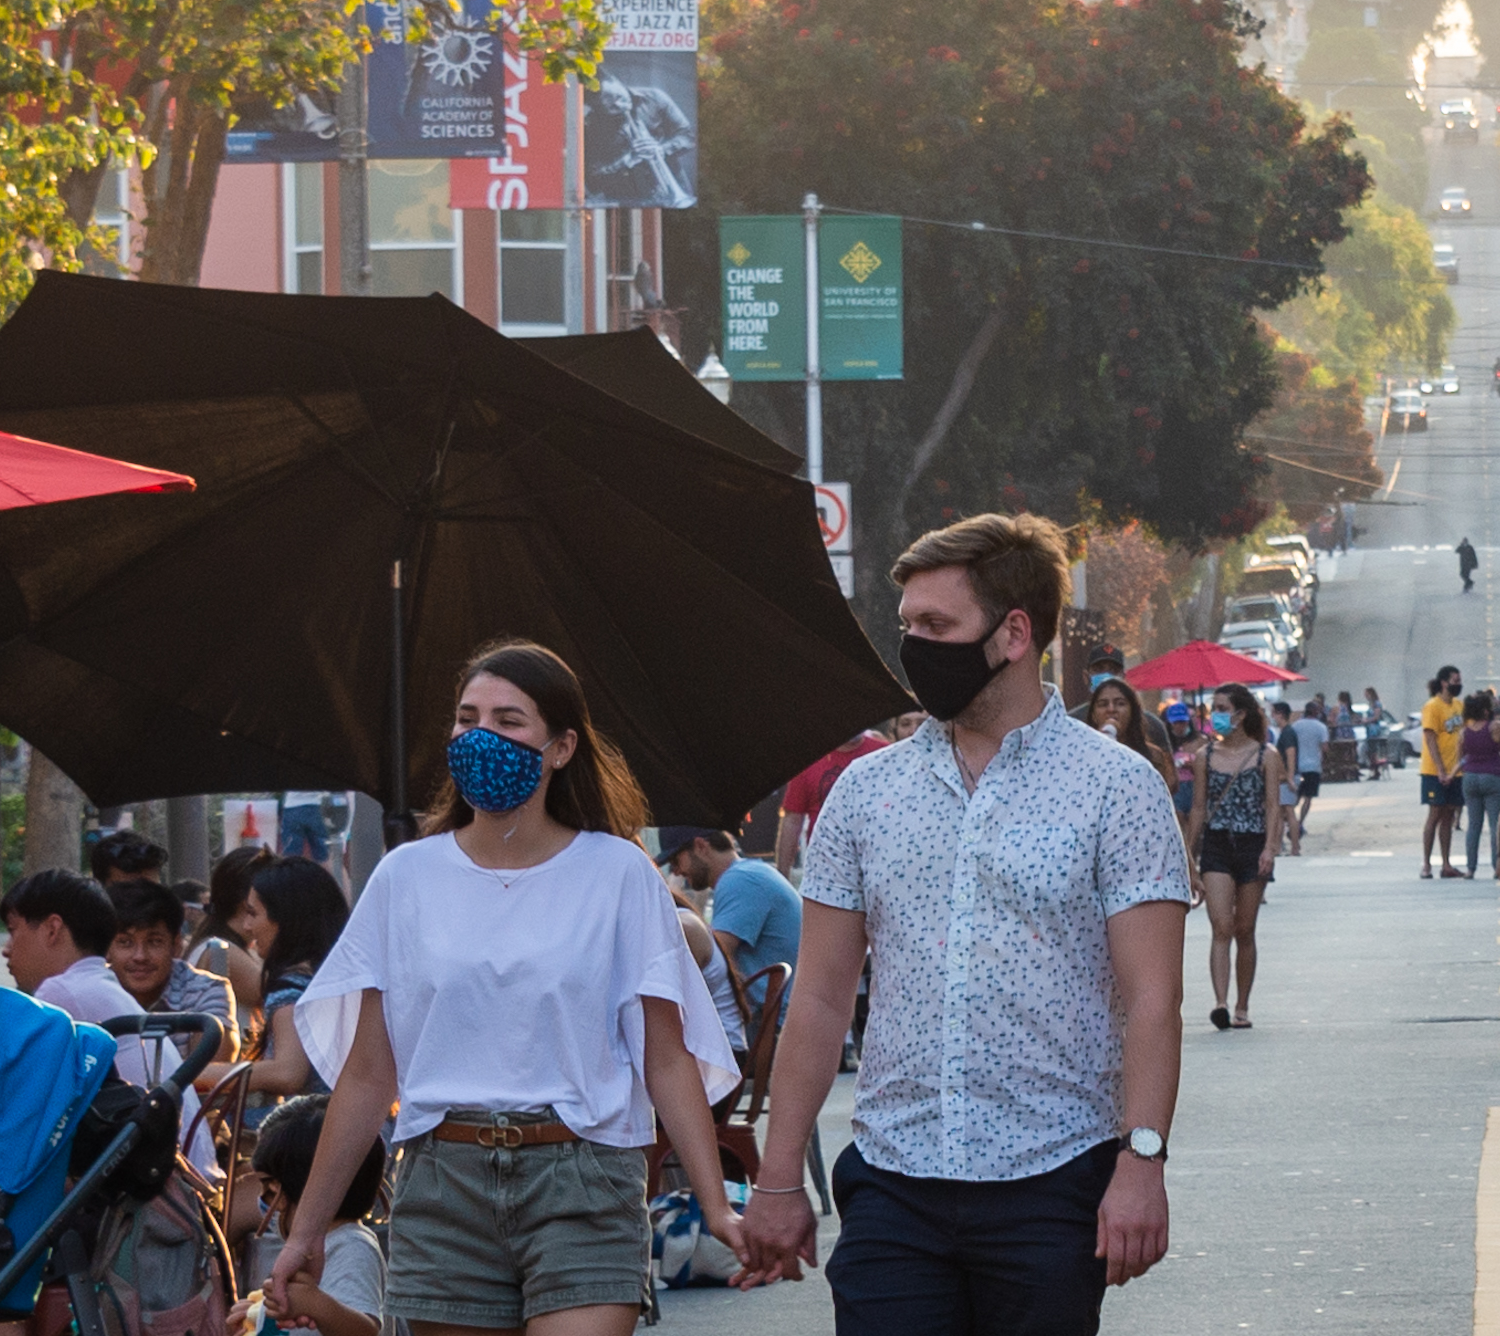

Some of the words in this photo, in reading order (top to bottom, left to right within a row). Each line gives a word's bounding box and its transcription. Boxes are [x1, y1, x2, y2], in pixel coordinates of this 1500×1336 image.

[601, 15, 632, 31] IVE
[635, 15, 671, 30] JAZZ
[676, 15, 695, 30] AT
[422, 96, 494, 109] CALIFORNIA
[422, 110, 479, 123] ACADEMY
[481, 110, 494, 122] OF
[421, 123, 496, 139] SCIENCES
[727, 267, 784, 284] CHANGE
[728, 285, 755, 301] THE
[823, 286, 881, 296] UNIVERSITY
[883, 286, 897, 296] OF
[728, 302, 780, 317] WORLD
[824, 297, 844, 307] SAN
[846, 297, 898, 307] FRANCISCO
[728, 318, 769, 334] FROM
[728, 335, 768, 351] HERE.
